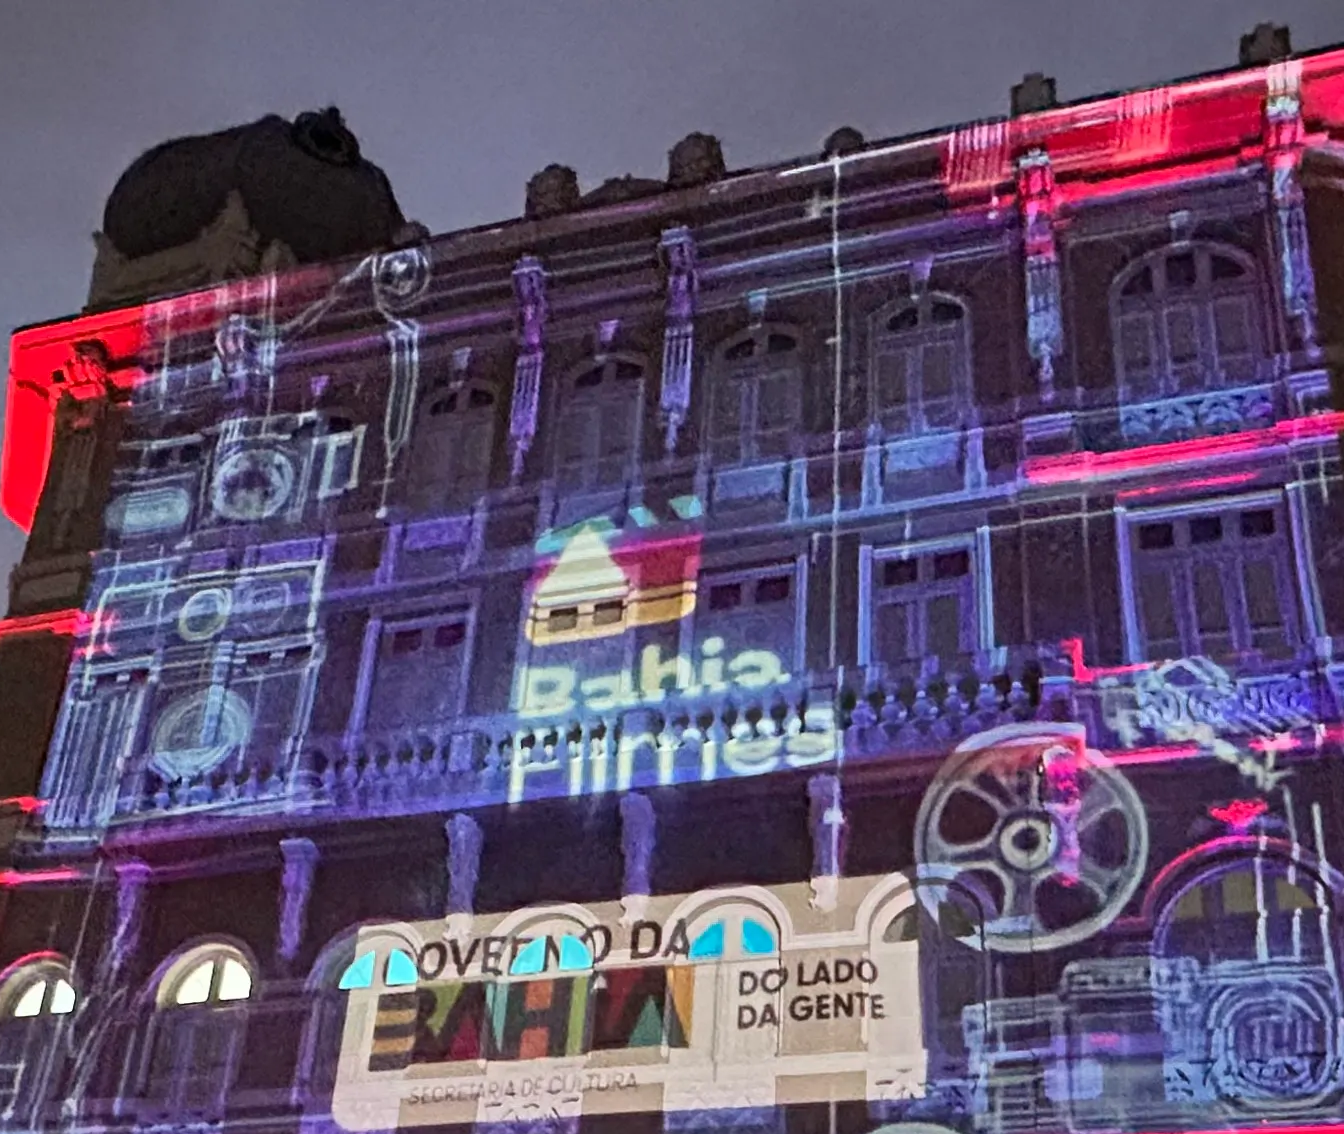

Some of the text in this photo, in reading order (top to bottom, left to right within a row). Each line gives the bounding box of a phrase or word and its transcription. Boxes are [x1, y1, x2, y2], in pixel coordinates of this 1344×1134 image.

[517, 637, 791, 718] Bahia
[630, 918, 690, 960] DA
[739, 959, 877, 996] DO LADO
[367, 965, 693, 1072] BAHIA
[738, 993, 886, 1030] DA GENTE
[407, 1072, 639, 1105] SECRETARIA DE CULTURA
